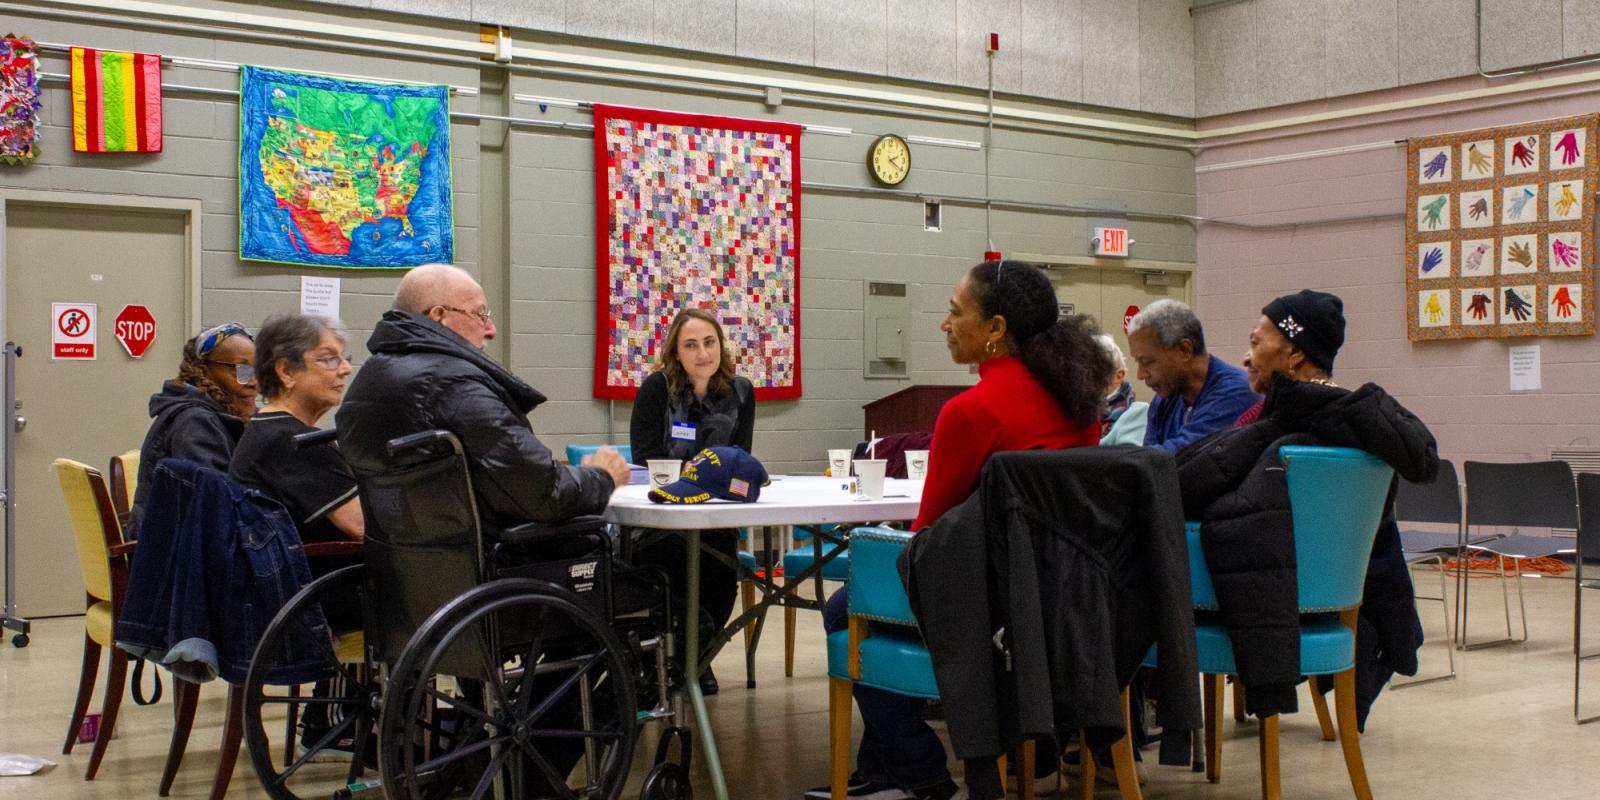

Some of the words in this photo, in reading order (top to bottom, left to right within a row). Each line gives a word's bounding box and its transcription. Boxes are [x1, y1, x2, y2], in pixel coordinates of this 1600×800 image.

[1103, 229, 1125, 253] EXIT
[117, 320, 154, 342] STOP
[75, 347, 89, 355] only
[683, 492, 711, 504] SERVED
[570, 561, 598, 572] DIRECT
[571, 568, 595, 578] SUPPLY
